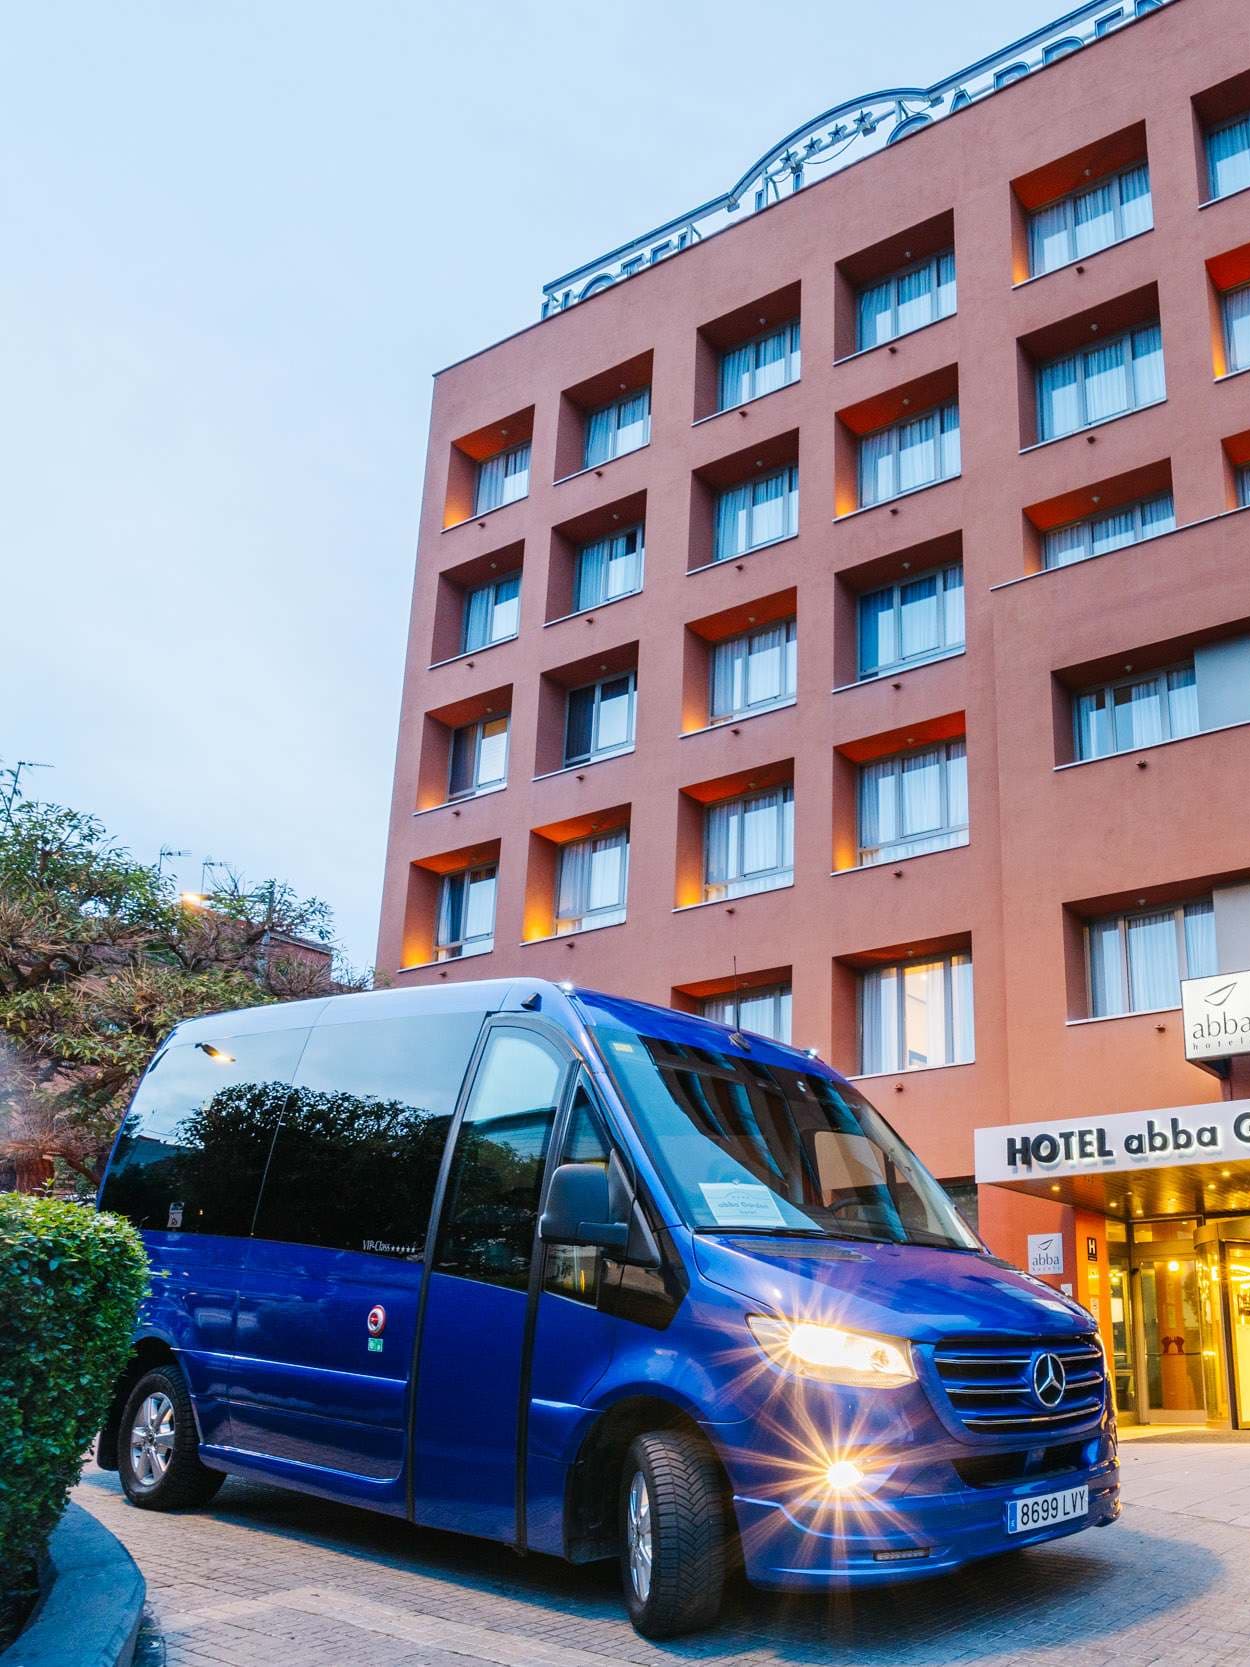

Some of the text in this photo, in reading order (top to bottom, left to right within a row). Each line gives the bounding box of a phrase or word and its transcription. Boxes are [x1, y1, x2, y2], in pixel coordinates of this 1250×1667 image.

[1006, 1128, 1114, 1167] HOTEL
[1124, 1118, 1218, 1155] abba
[1032, 1253, 1060, 1266] abba
[1088, 1239, 1096, 1254] H
[1021, 1489, 1085, 1526] 8699 LVY
